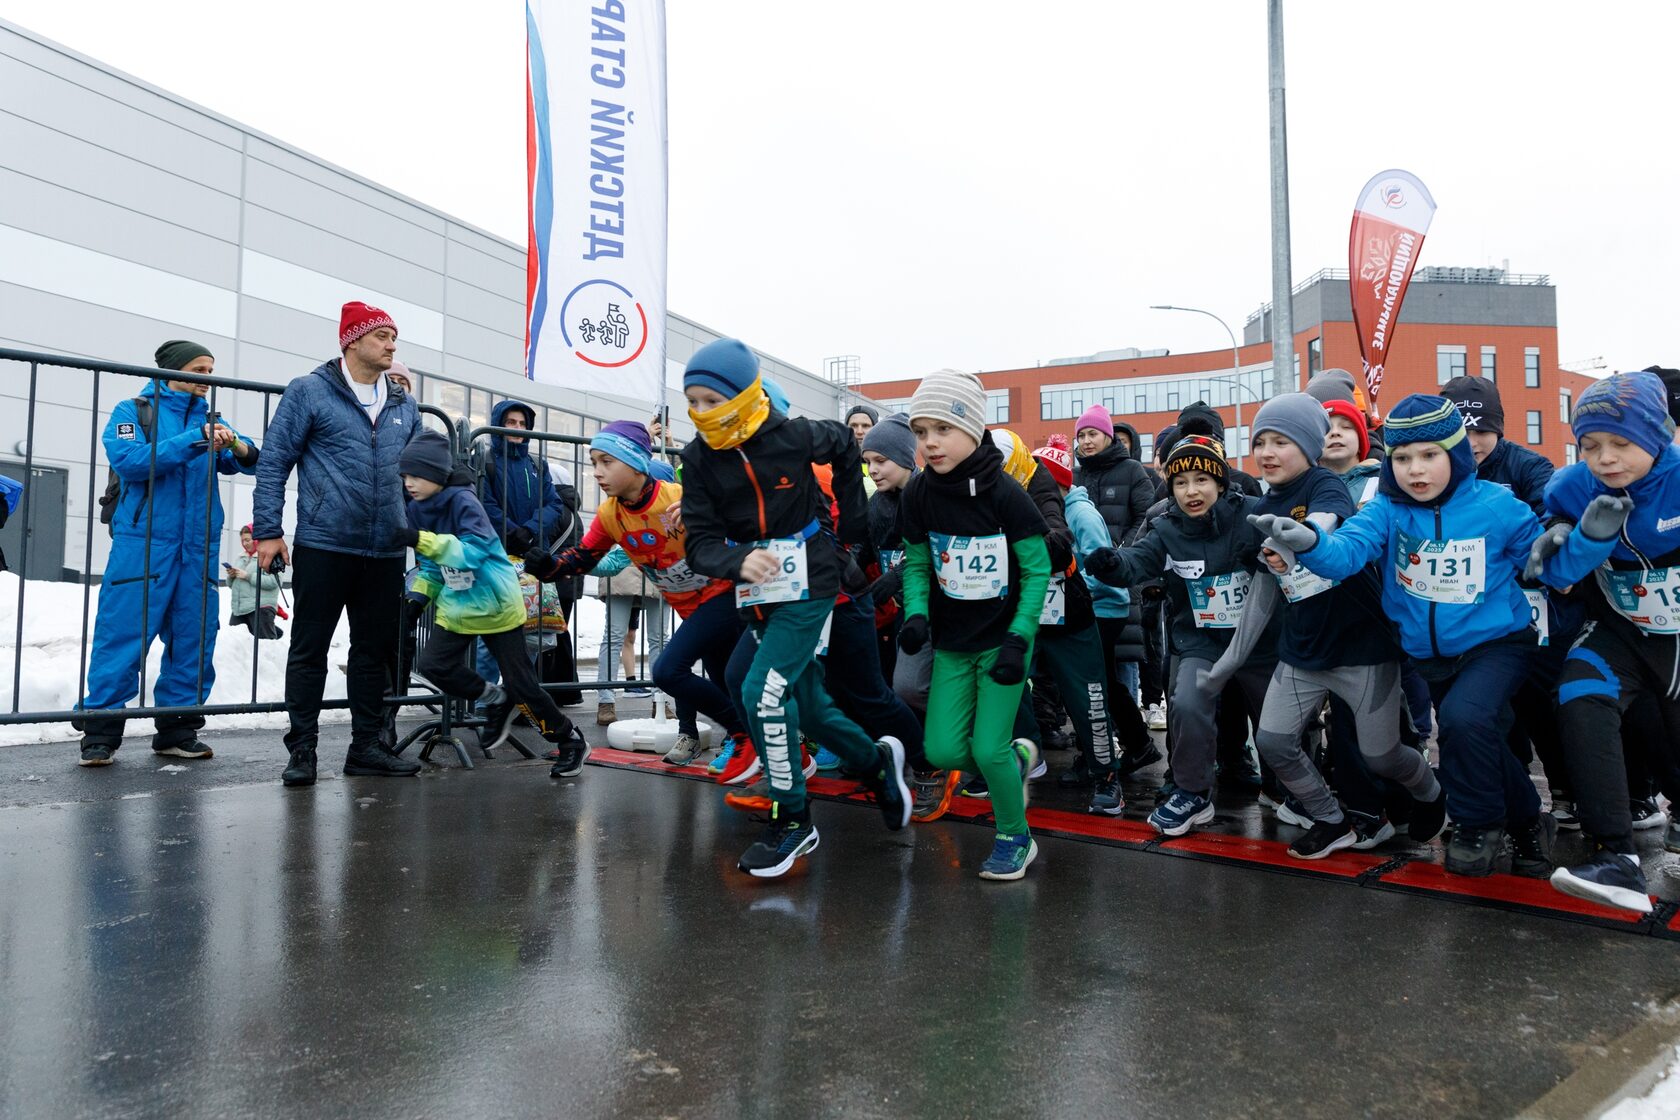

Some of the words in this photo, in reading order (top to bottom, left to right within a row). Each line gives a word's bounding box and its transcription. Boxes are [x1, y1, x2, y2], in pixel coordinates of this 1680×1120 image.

[1372, 232, 1416, 350] ЗАМЫКАЮЩИЙ
[664, 568, 695, 584] 135
[955, 555, 997, 573] 142
[1427, 557, 1471, 577] 131
[757, 668, 788, 717] ВЛАД
[1088, 683, 1106, 720] ВЛАД
[763, 723, 793, 791] БУМАГА
[1091, 721, 1111, 765] БУМАГА
